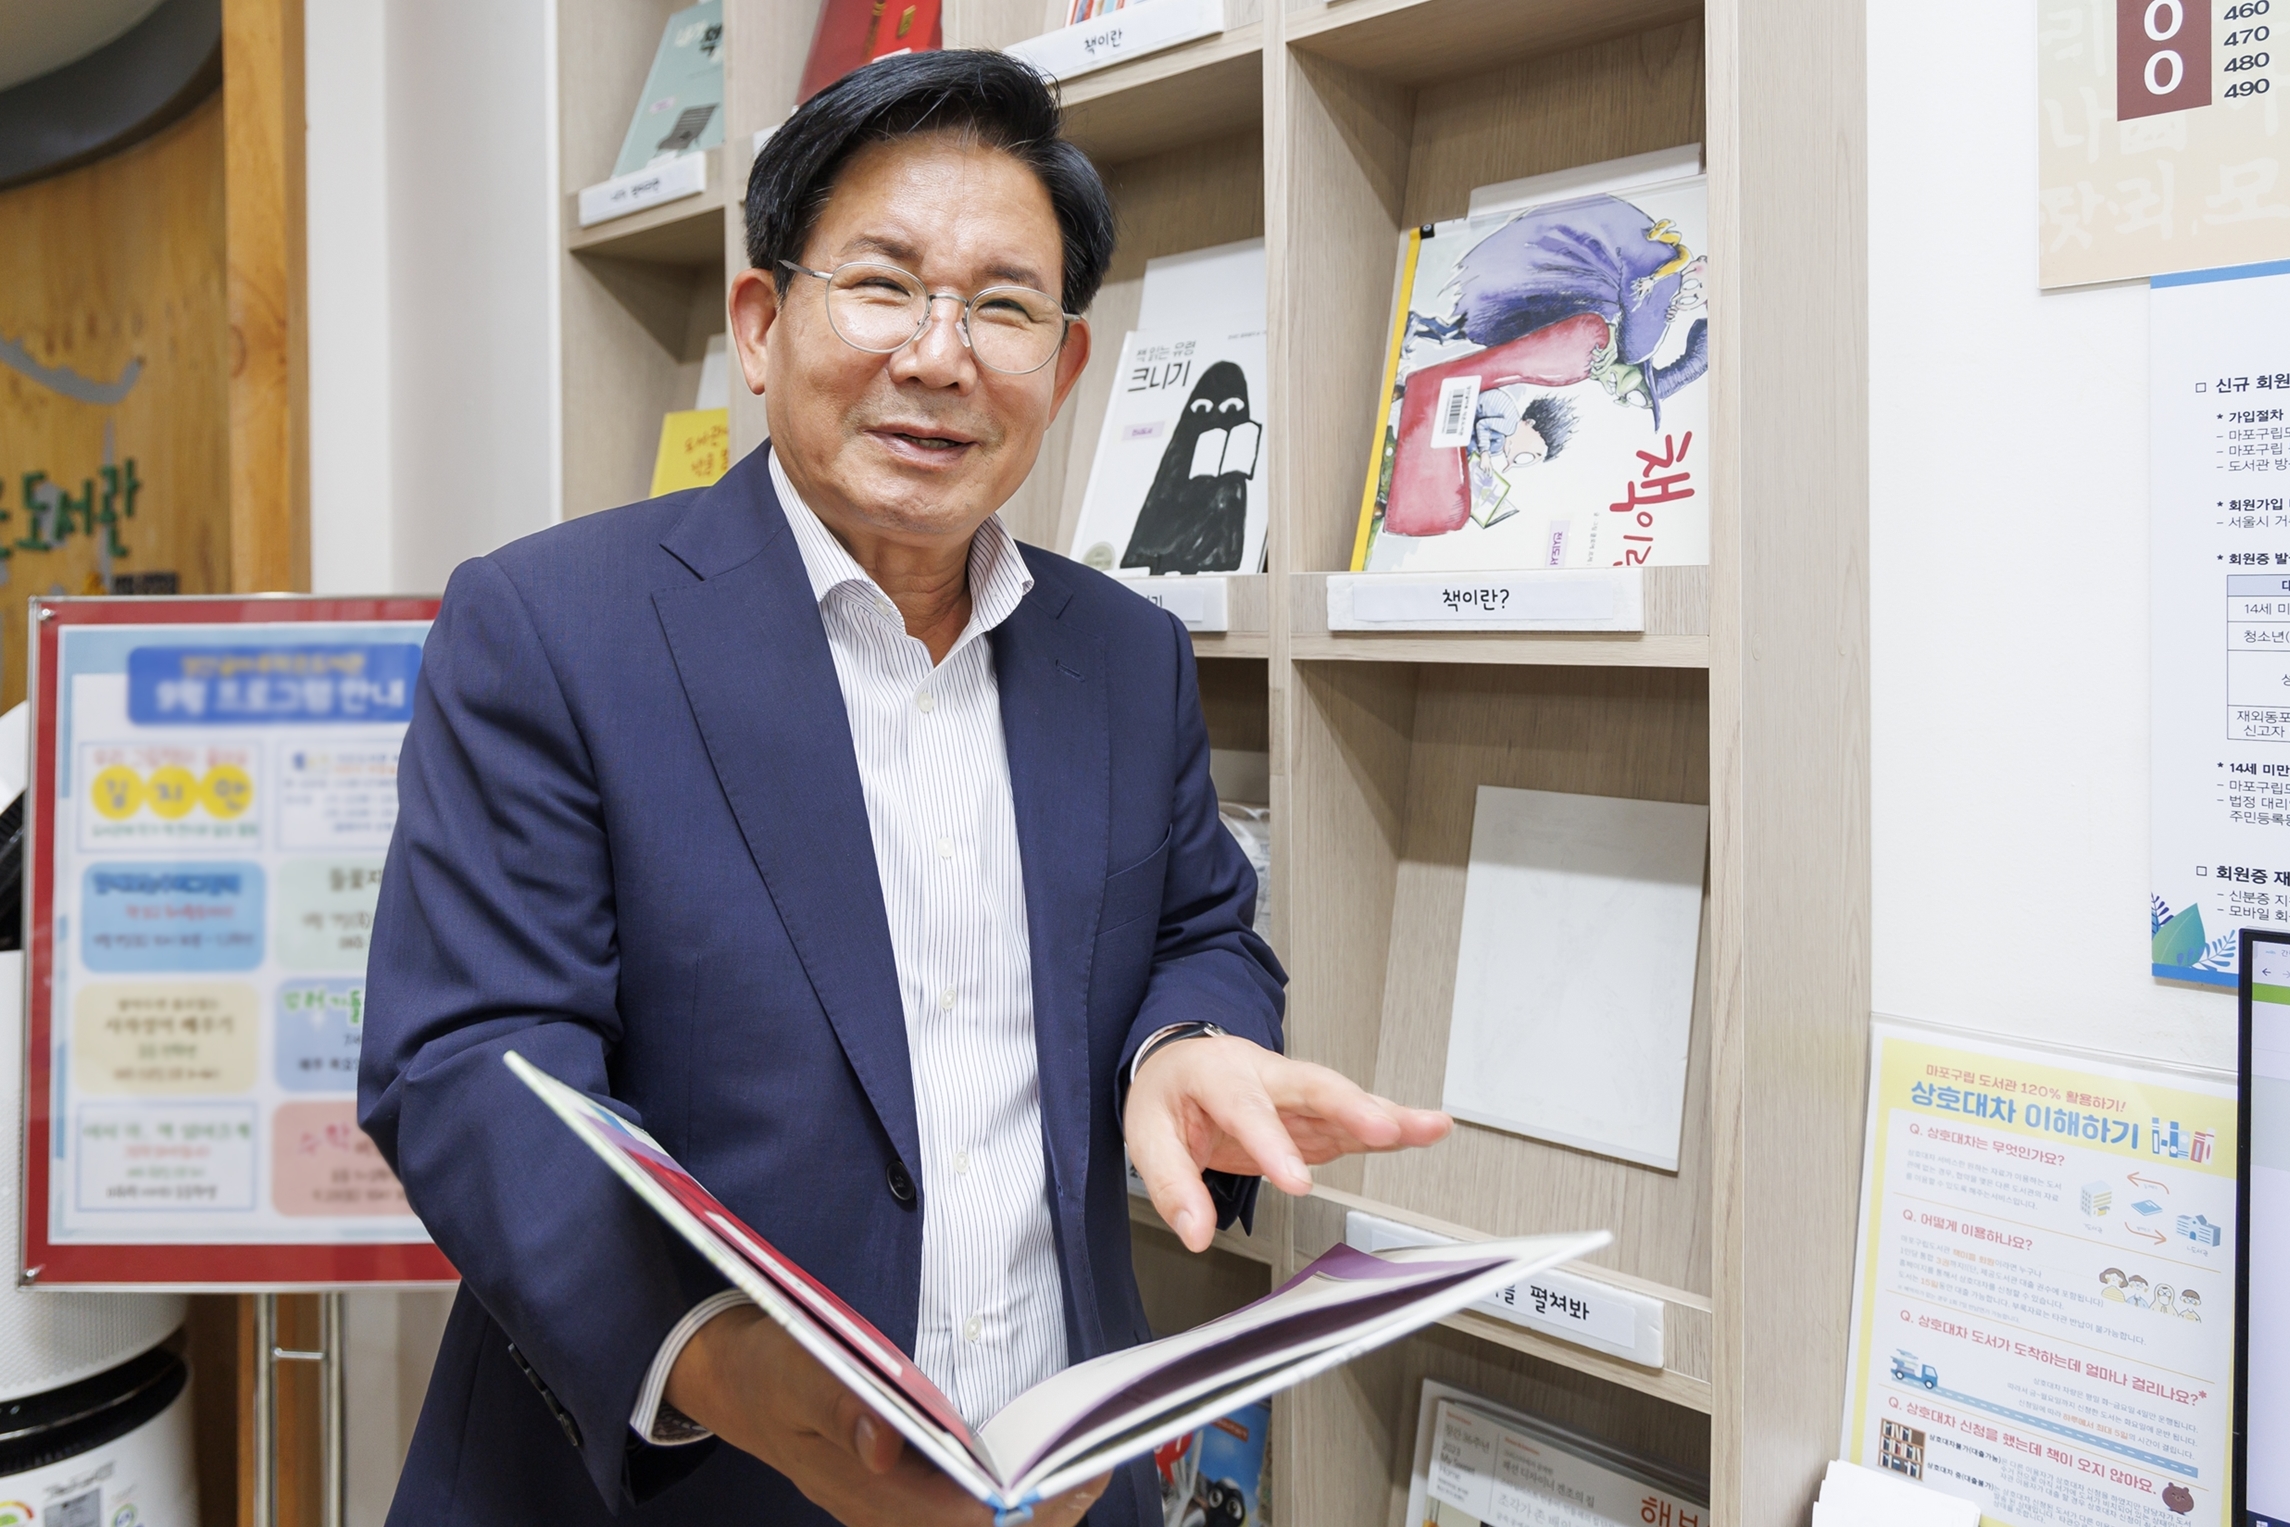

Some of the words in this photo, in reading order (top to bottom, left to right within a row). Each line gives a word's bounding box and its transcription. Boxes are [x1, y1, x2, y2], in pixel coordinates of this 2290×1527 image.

[2224, 0, 2270, 20] 460
[2224, 26, 2270, 46] 470
[2224, 52, 2270, 72] 480
[2224, 78, 2270, 98] 490
[1173, 340, 1196, 357] 유령
[1128, 360, 1191, 392] 크니기
[2216, 377, 2250, 393] 신규
[2229, 409, 2283, 423] 가입절차
[2229, 442, 2282, 456] 마포구립
[2229, 459, 2269, 472] 도서관
[2275, 458, 2290, 471] 방
[2229, 498, 2283, 511] 회원가입
[2228, 516, 2268, 528] 서울시
[2275, 515, 2290, 527] 거
[1550, 531, 1564, 565] 전시도서
[2229, 553, 2269, 565] 회원증
[2275, 553, 2290, 564] 발
[1442, 588, 1510, 611] 책이란?
[2245, 603, 2271, 615] 14세
[2237, 710, 2290, 723] 재외동포
[2244, 725, 2285, 737] 신고자
[2230, 763, 2257, 775] 14세
[2263, 764, 2290, 776] 미만
[2230, 795, 2256, 808] 법정
[2262, 797, 2290, 810] 대리
[2217, 866, 2268, 884] 회원증
[2229, 891, 2270, 905] 신분증
[2275, 895, 2290, 907] 지
[2229, 906, 2269, 920] 모바일
[2275, 910, 2290, 922] 회
[1926, 1063, 1974, 1084] 마포구립
[1978, 1073, 2016, 1092] 도서관
[2020, 1081, 2061, 1101] 120%
[2065, 1090, 2126, 1114] 활용하기!
[1910, 1078, 2016, 1124] 상호대차
[2024, 1101, 2138, 1150] 이해하기
[1909, 1122, 1922, 1136] Q.
[1927, 1126, 1988, 1150] 상호대차는
[1992, 1140, 2064, 1167] 무엇인가요?
[2046, 1180, 2061, 1190] 도서
[2043, 1192, 2058, 1202] 자료
[1902, 1208, 1916, 1222] Q.
[1920, 1212, 1957, 1233] 어떻게
[1961, 1222, 2032, 1252] 이용하나요?
[1530, 1285, 1590, 1320] 펼쳐봐
[2051, 1312, 2067, 1324] 타관
[2069, 1317, 2093, 1331] 반납이
[2095, 1324, 2146, 1346] 불가능합니다.
[1899, 1308, 1914, 1323] Q.
[1918, 1314, 1967, 1339] 상호대차
[1971, 1329, 2010, 1352] 도서가
[2014, 1341, 2080, 1373] 도착하는데
[2085, 1362, 2127, 1386] 얼마나
[2047, 1407, 2061, 1419] 따라
[2137, 1435, 2160, 1450] 시간이
[2100, 1410, 2122, 1424] 도서는
[2124, 1418, 2153, 1434] 화요일에
[2155, 1427, 2170, 1439] 운반
[1888, 1395, 1902, 1410] Q.
[1906, 1401, 1955, 1428] 상호대차
[1960, 1419, 1997, 1442] 신청을
[2002, 1433, 2041, 1456] 했는데
[2046, 1447, 2072, 1467] 책이
[2077, 1457, 2104, 1477] 오지
[2109, 1467, 2156, 1494] 않아요.
